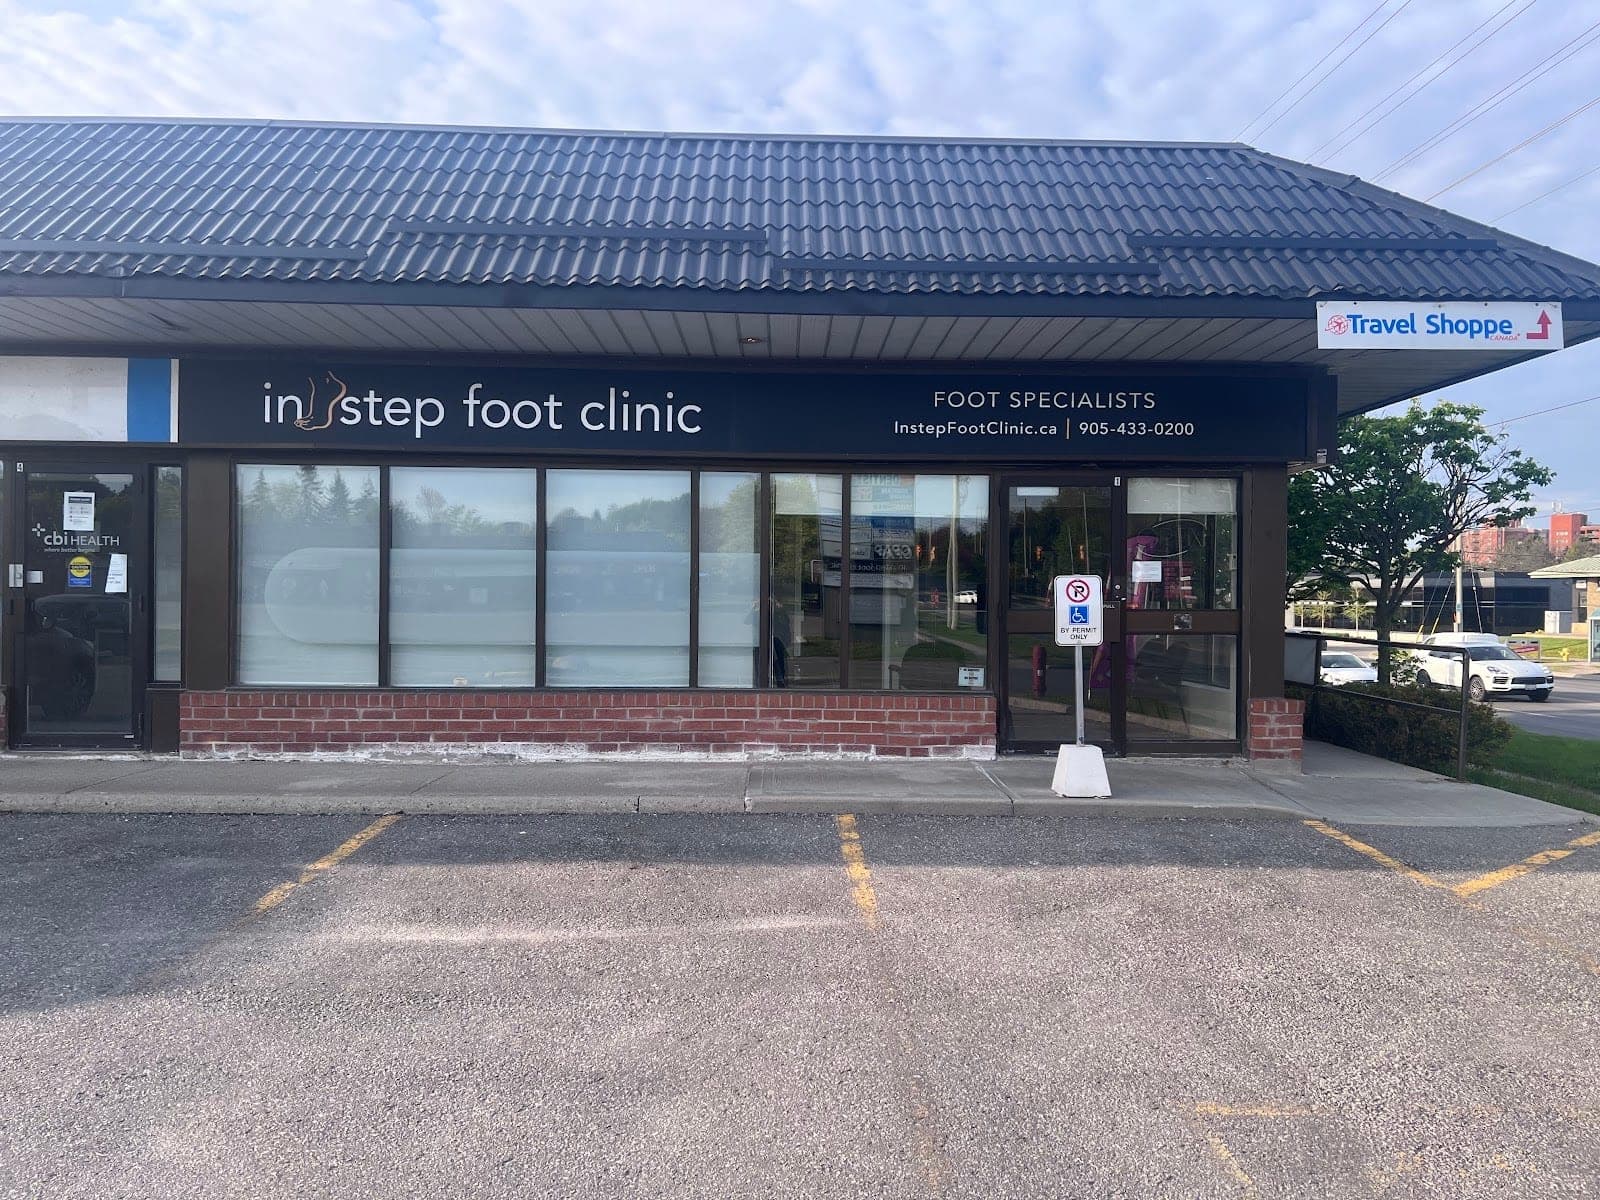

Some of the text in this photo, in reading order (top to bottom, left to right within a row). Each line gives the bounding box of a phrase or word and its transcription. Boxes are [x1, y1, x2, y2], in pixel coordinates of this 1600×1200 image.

[1347, 313, 1513, 339] Travel Shoppe
[463, 383, 563, 430] foot
[580, 387, 702, 434] clinic
[934, 391, 1156, 409] FOOT SPECIALISTS
[894, 420, 1194, 438] InstepFootClinic.ca 905-433-0200
[44, 531, 120, 546] cbi HEALTH
